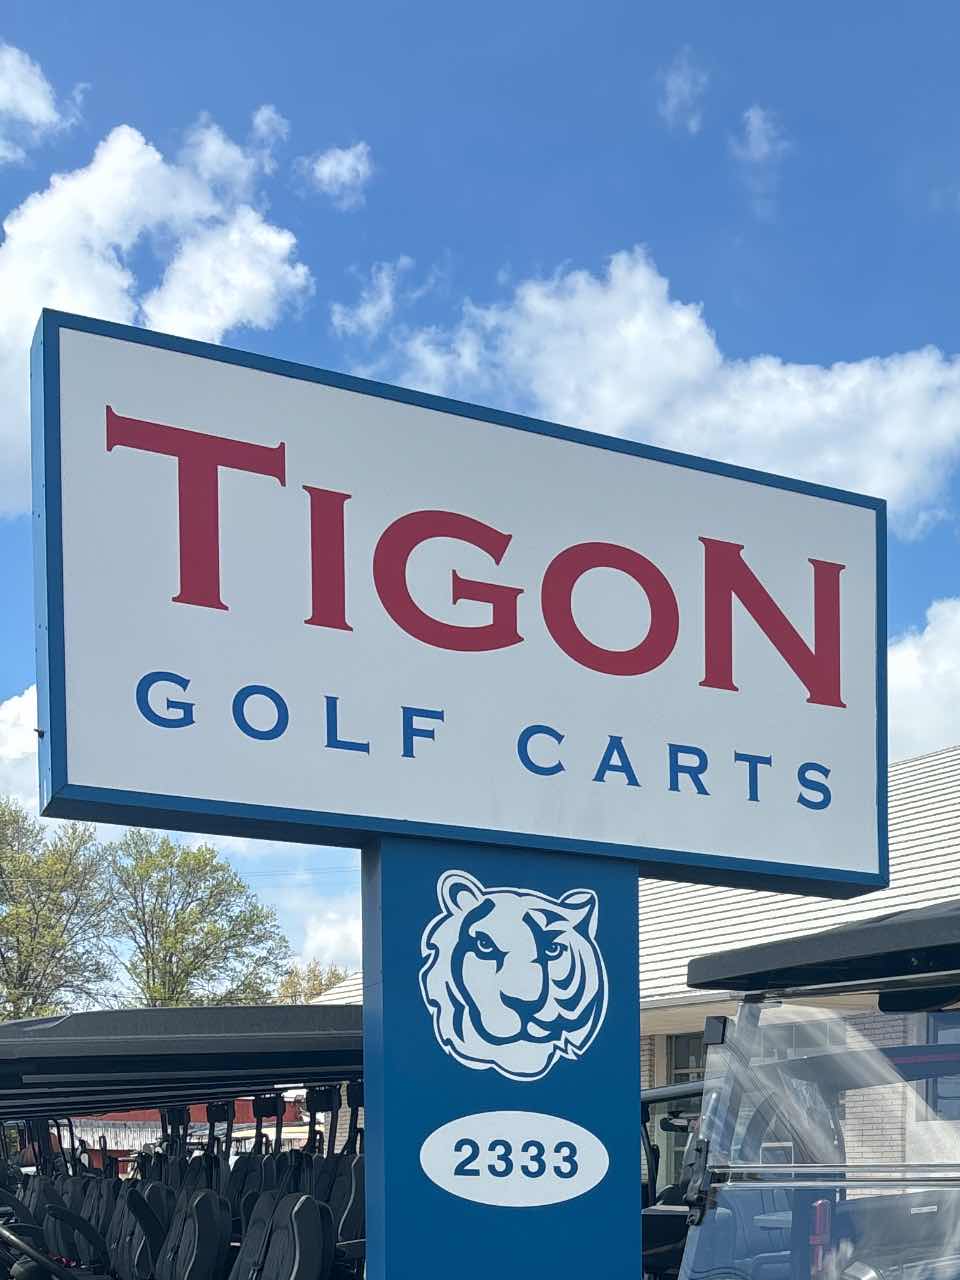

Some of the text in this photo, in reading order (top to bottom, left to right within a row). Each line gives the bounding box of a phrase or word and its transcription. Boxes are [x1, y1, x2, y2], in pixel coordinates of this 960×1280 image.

[106, 405, 847, 708] TIGON
[136, 671, 833, 811] GOLF CARTS
[453, 1138, 579, 1179] 2333
